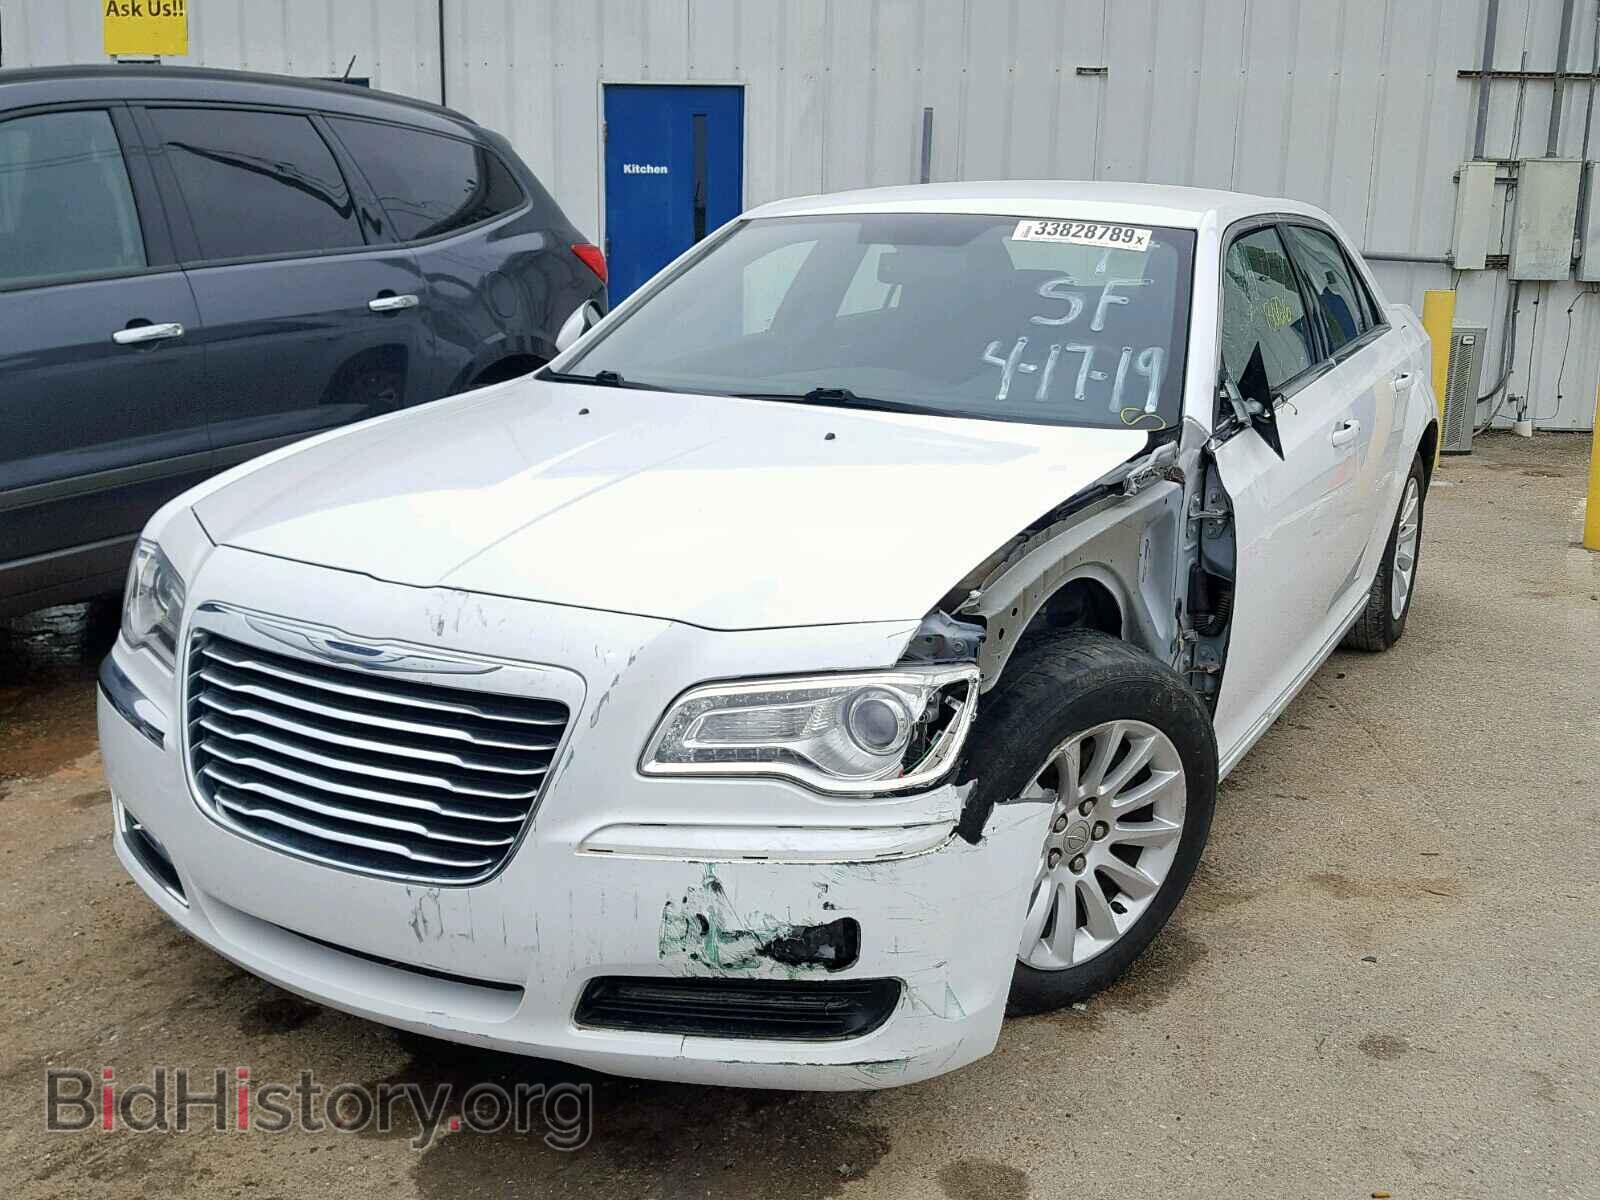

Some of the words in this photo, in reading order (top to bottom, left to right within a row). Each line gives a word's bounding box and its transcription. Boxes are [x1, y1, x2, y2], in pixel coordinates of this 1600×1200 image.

[106, 0, 143, 17] Ask
[148, 0, 184, 17] Us!!
[623, 163, 668, 174] Kitchen
[982, 336, 1165, 413] 4-17-19
